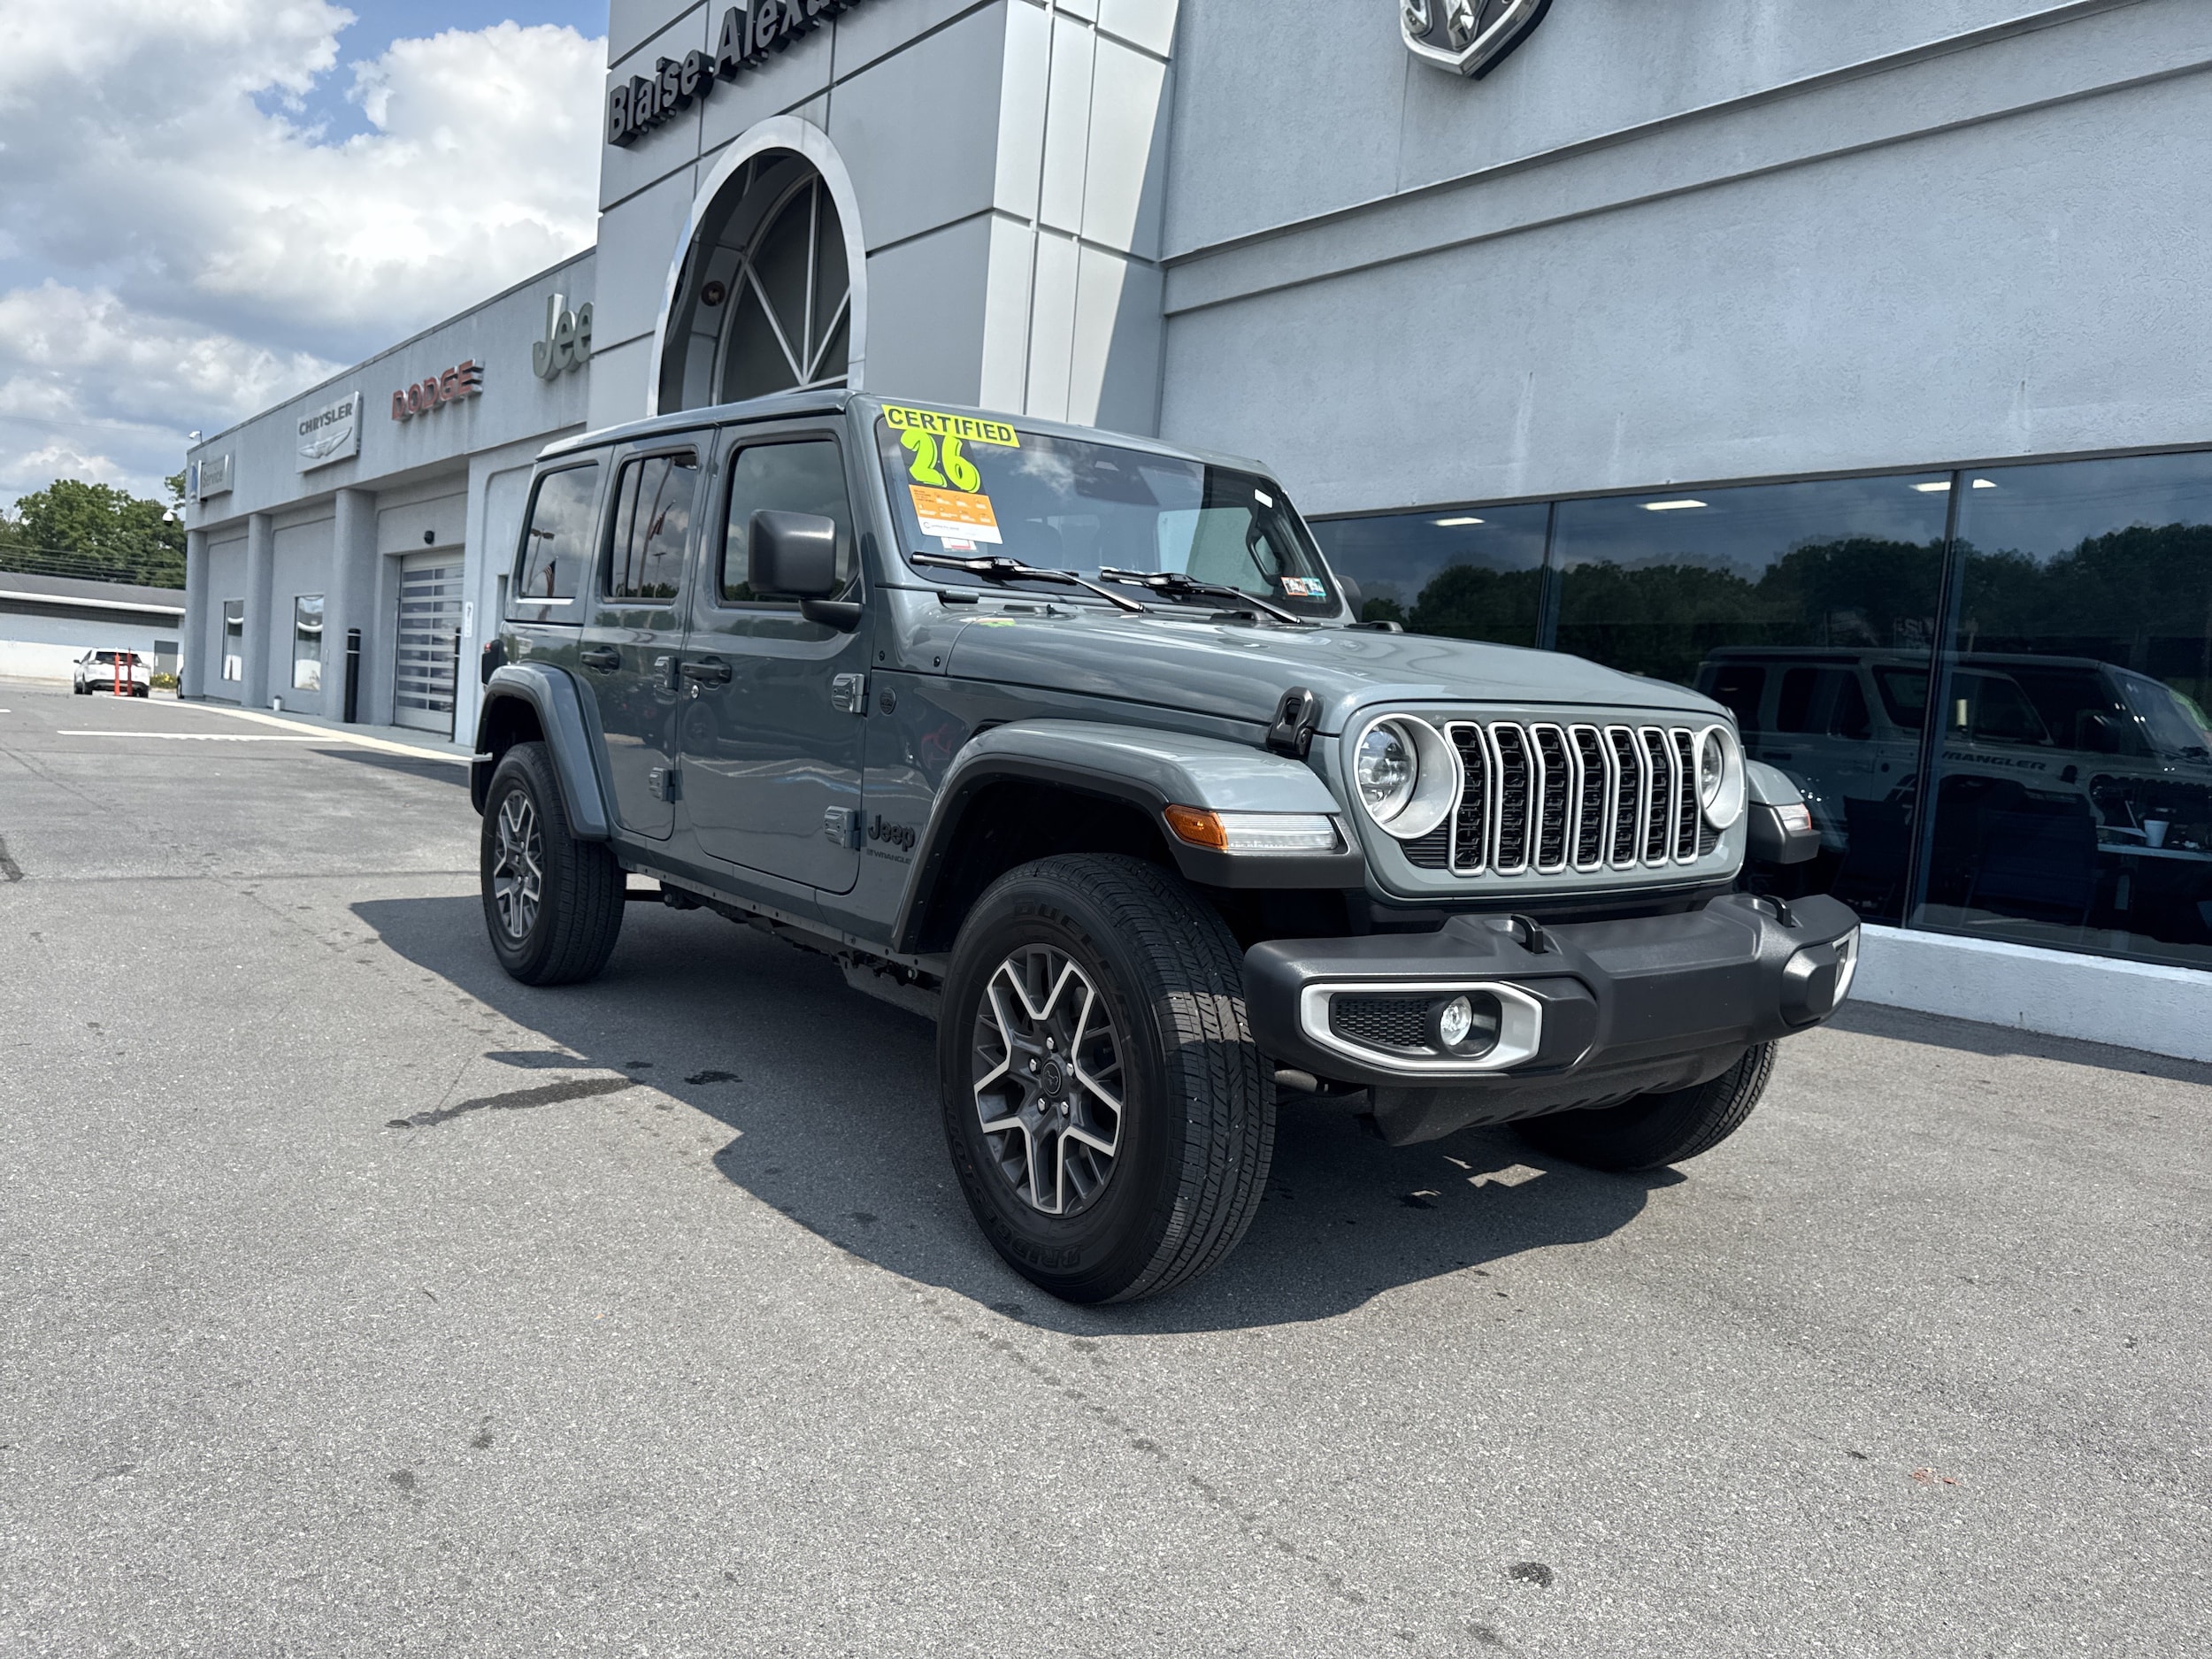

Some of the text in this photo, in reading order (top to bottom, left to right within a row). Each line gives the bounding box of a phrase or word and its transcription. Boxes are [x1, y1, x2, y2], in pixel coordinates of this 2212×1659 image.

[609, 50, 713, 148] Blaise
[533, 293, 594, 380] Jee
[392, 358, 483, 422] DODGE
[299, 403, 353, 436] CHRYSLER
[887, 408, 1012, 443] CERTIFIED
[900, 427, 981, 494] 26
[868, 814, 916, 852] Jeep
[874, 849, 912, 865] WRANGLE
